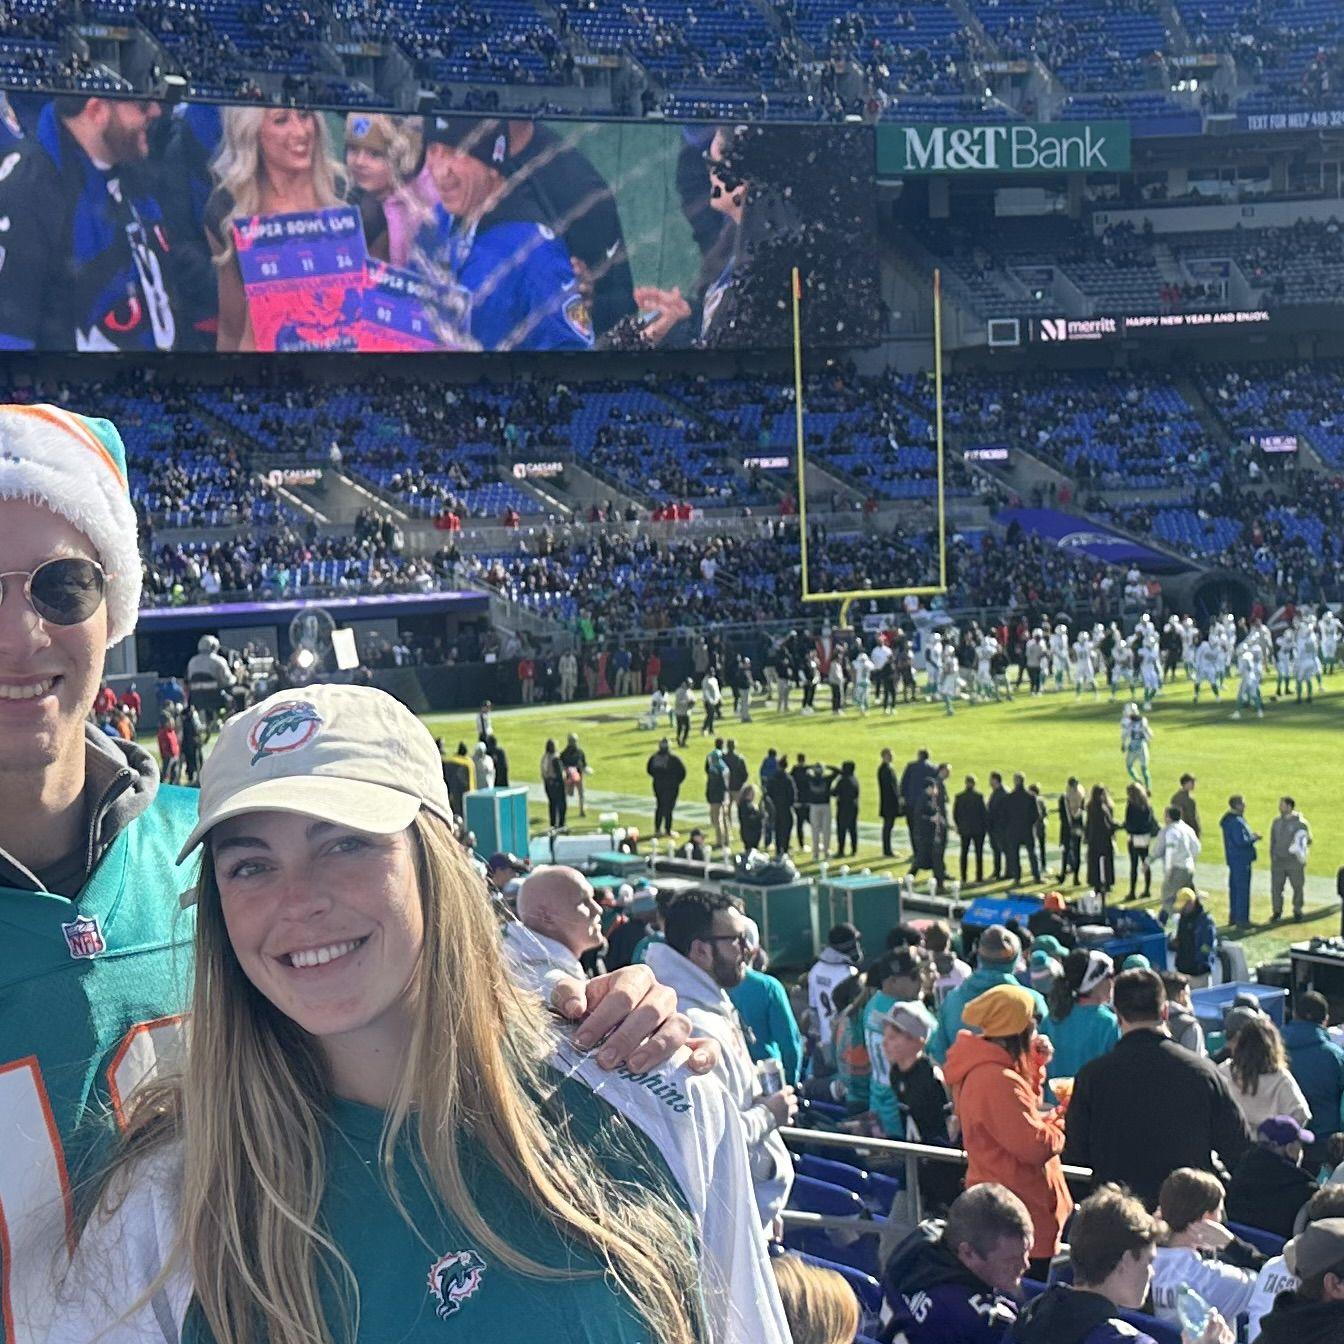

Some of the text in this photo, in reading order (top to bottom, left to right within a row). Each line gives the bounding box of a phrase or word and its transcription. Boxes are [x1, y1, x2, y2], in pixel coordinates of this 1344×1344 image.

[1248, 114, 1268, 130] TEXT
[1269, 114, 1286, 129] FOR
[1288, 112, 1309, 128] HELP
[902, 126, 1108, 170] M&T Bank
[241, 220, 284, 240] SUPER
[286, 218, 326, 235] BOWL
[1068, 317, 1116, 333] merritt
[1125, 316, 1157, 328] HAPPY
[1160, 314, 1183, 326] NEW
[1185, 313, 1211, 324] YEAR
[1213, 312, 1234, 323] AND
[69, 931, 103, 955] NFL
